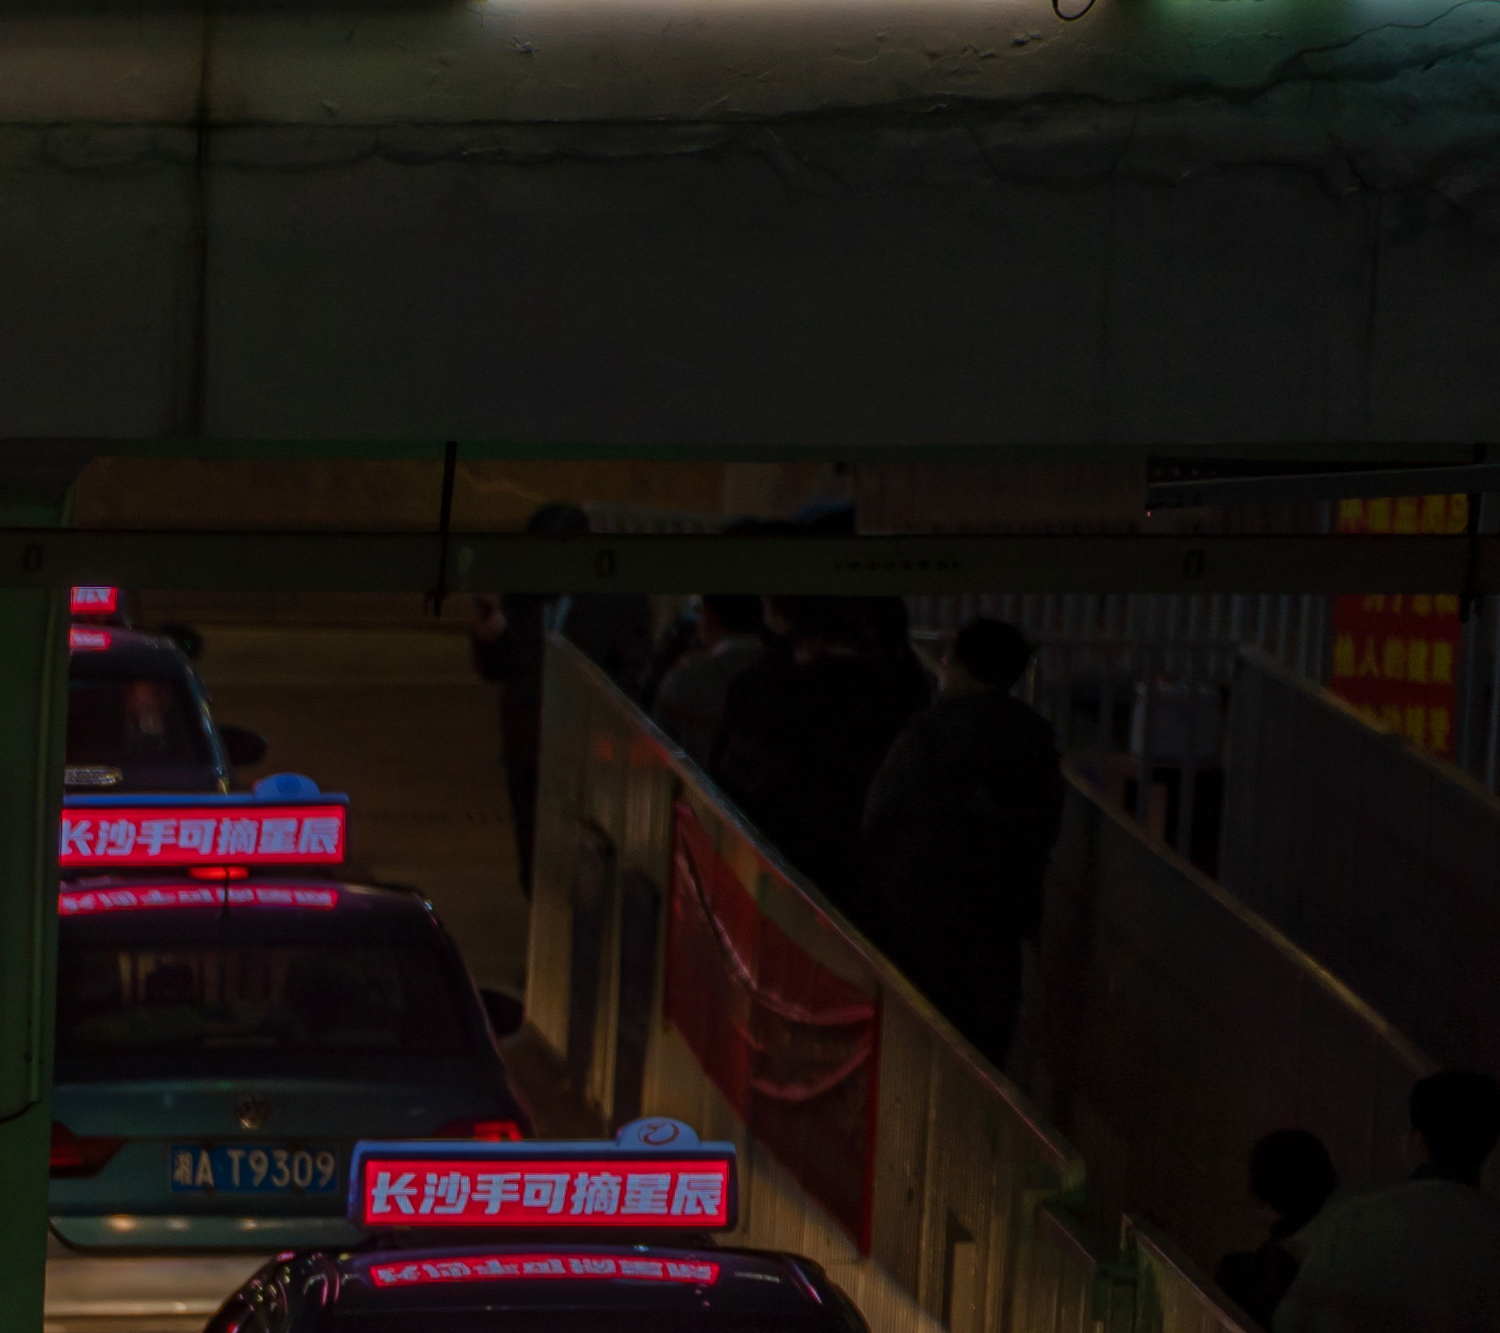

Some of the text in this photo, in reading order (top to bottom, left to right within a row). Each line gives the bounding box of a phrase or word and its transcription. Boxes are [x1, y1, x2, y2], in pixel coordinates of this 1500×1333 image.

[60, 818, 339, 855] 长沙手可摘星辰
[372, 1172, 723, 1215] 长沙手可摘星辰
